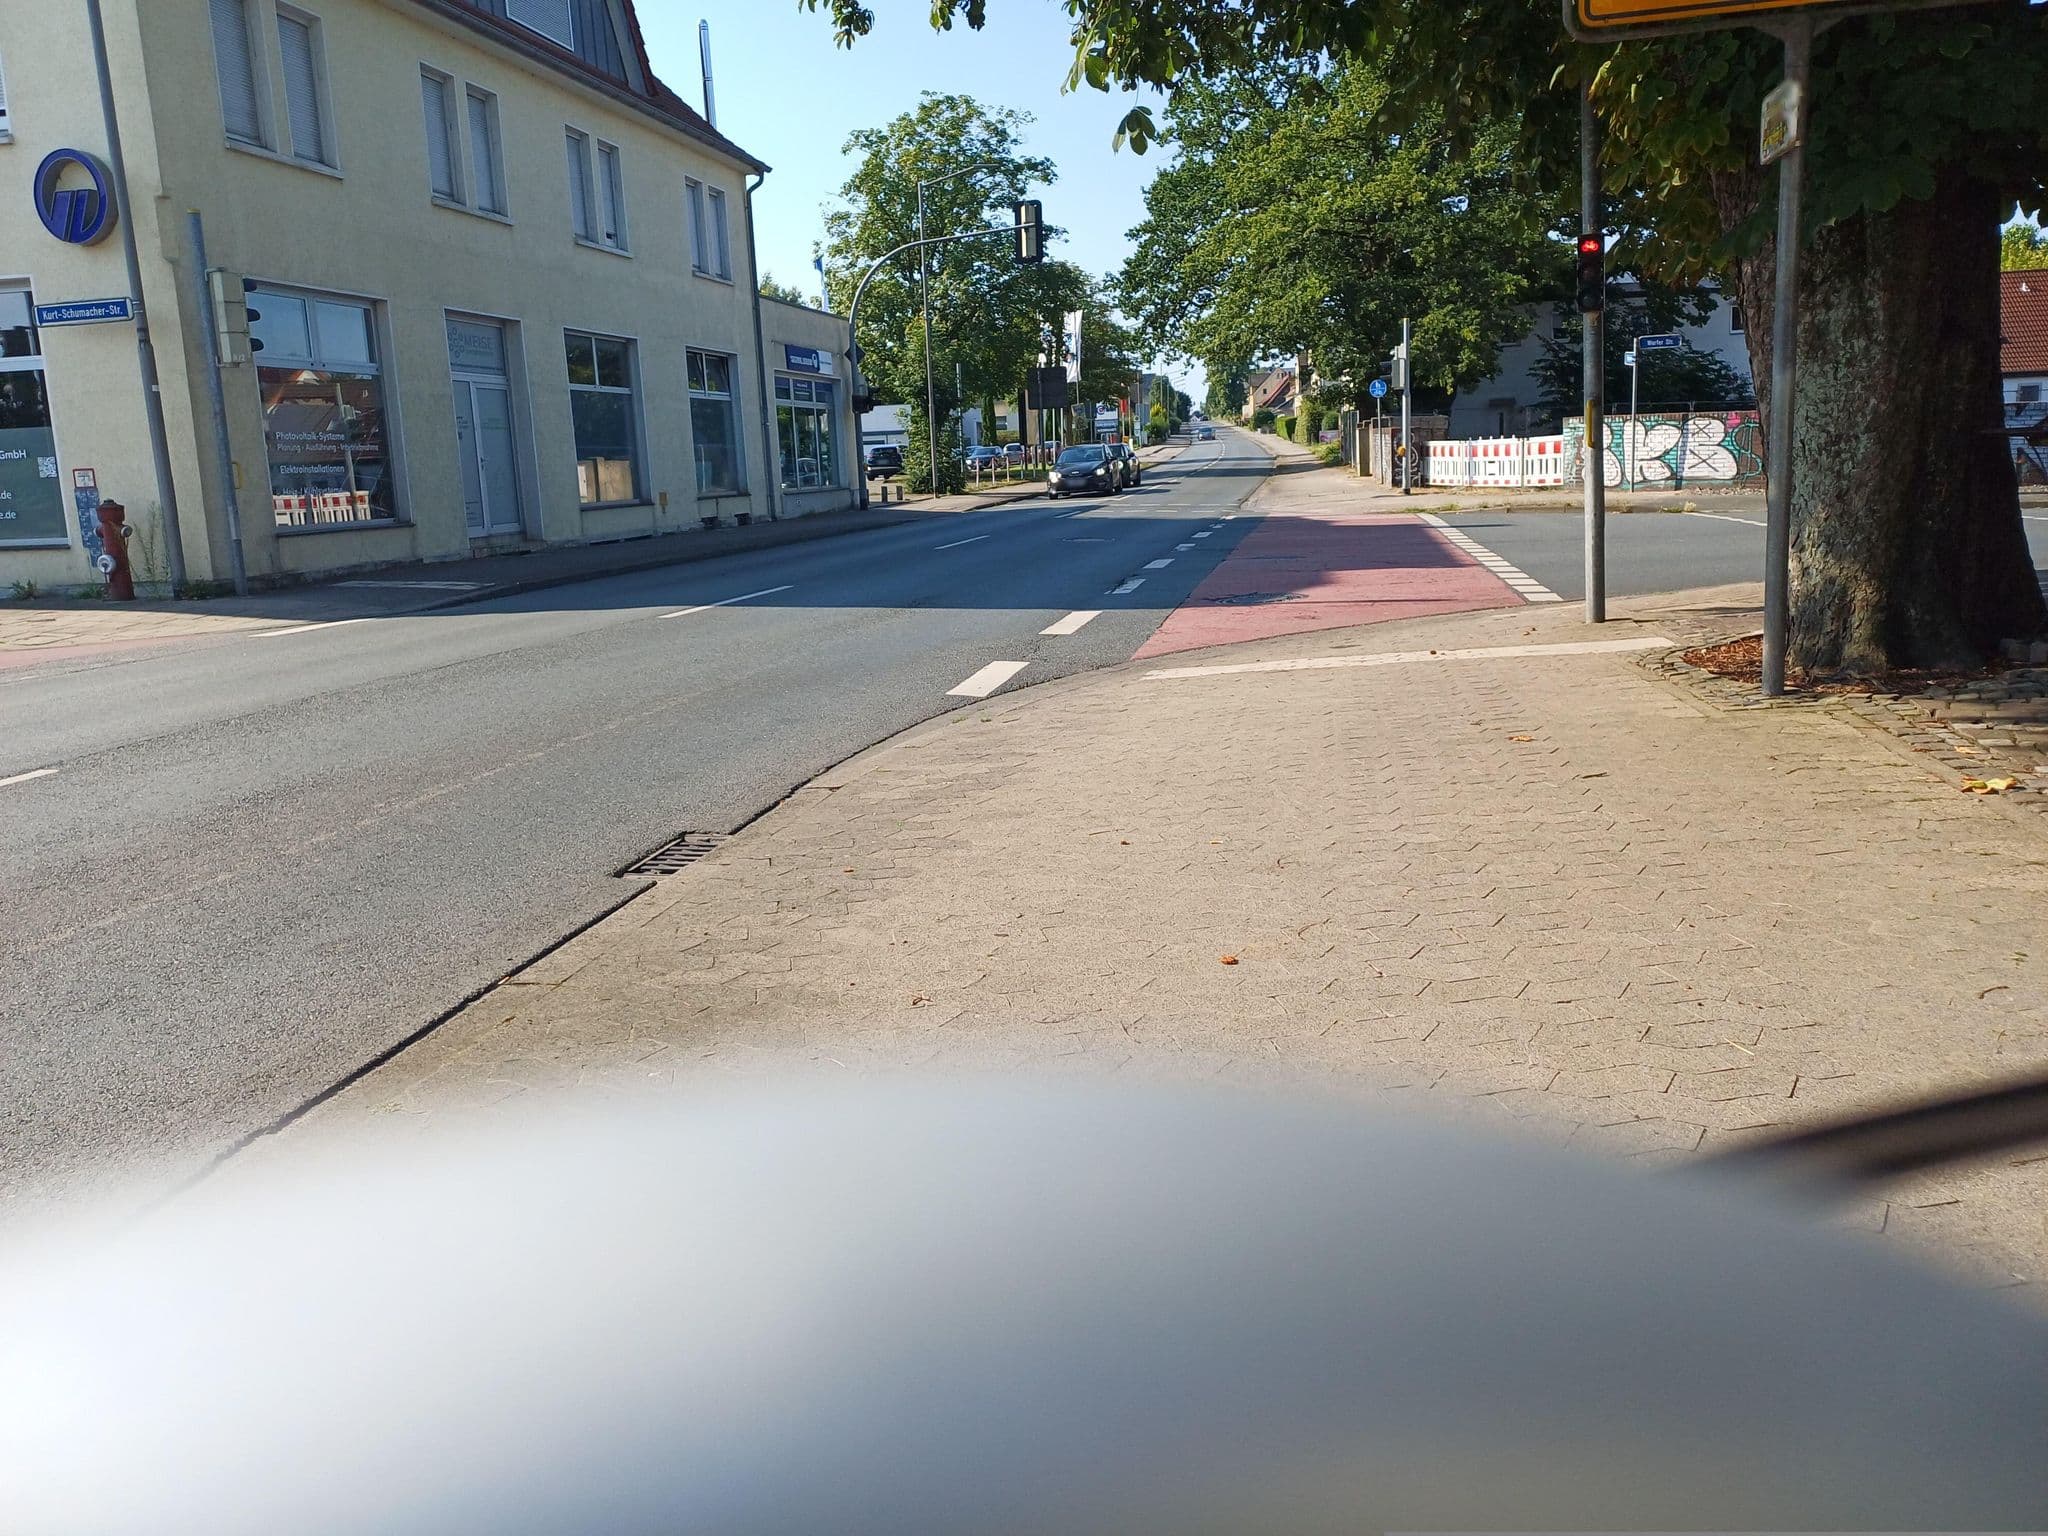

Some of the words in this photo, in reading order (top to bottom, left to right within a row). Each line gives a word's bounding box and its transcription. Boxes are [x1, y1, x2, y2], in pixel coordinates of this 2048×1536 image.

[42, 304, 123, 320] Kurt-Schumacher-Str.
[276, 431, 345, 442] Photovoltaik-Systeme
[0, 449, 27, 459] GmbH
